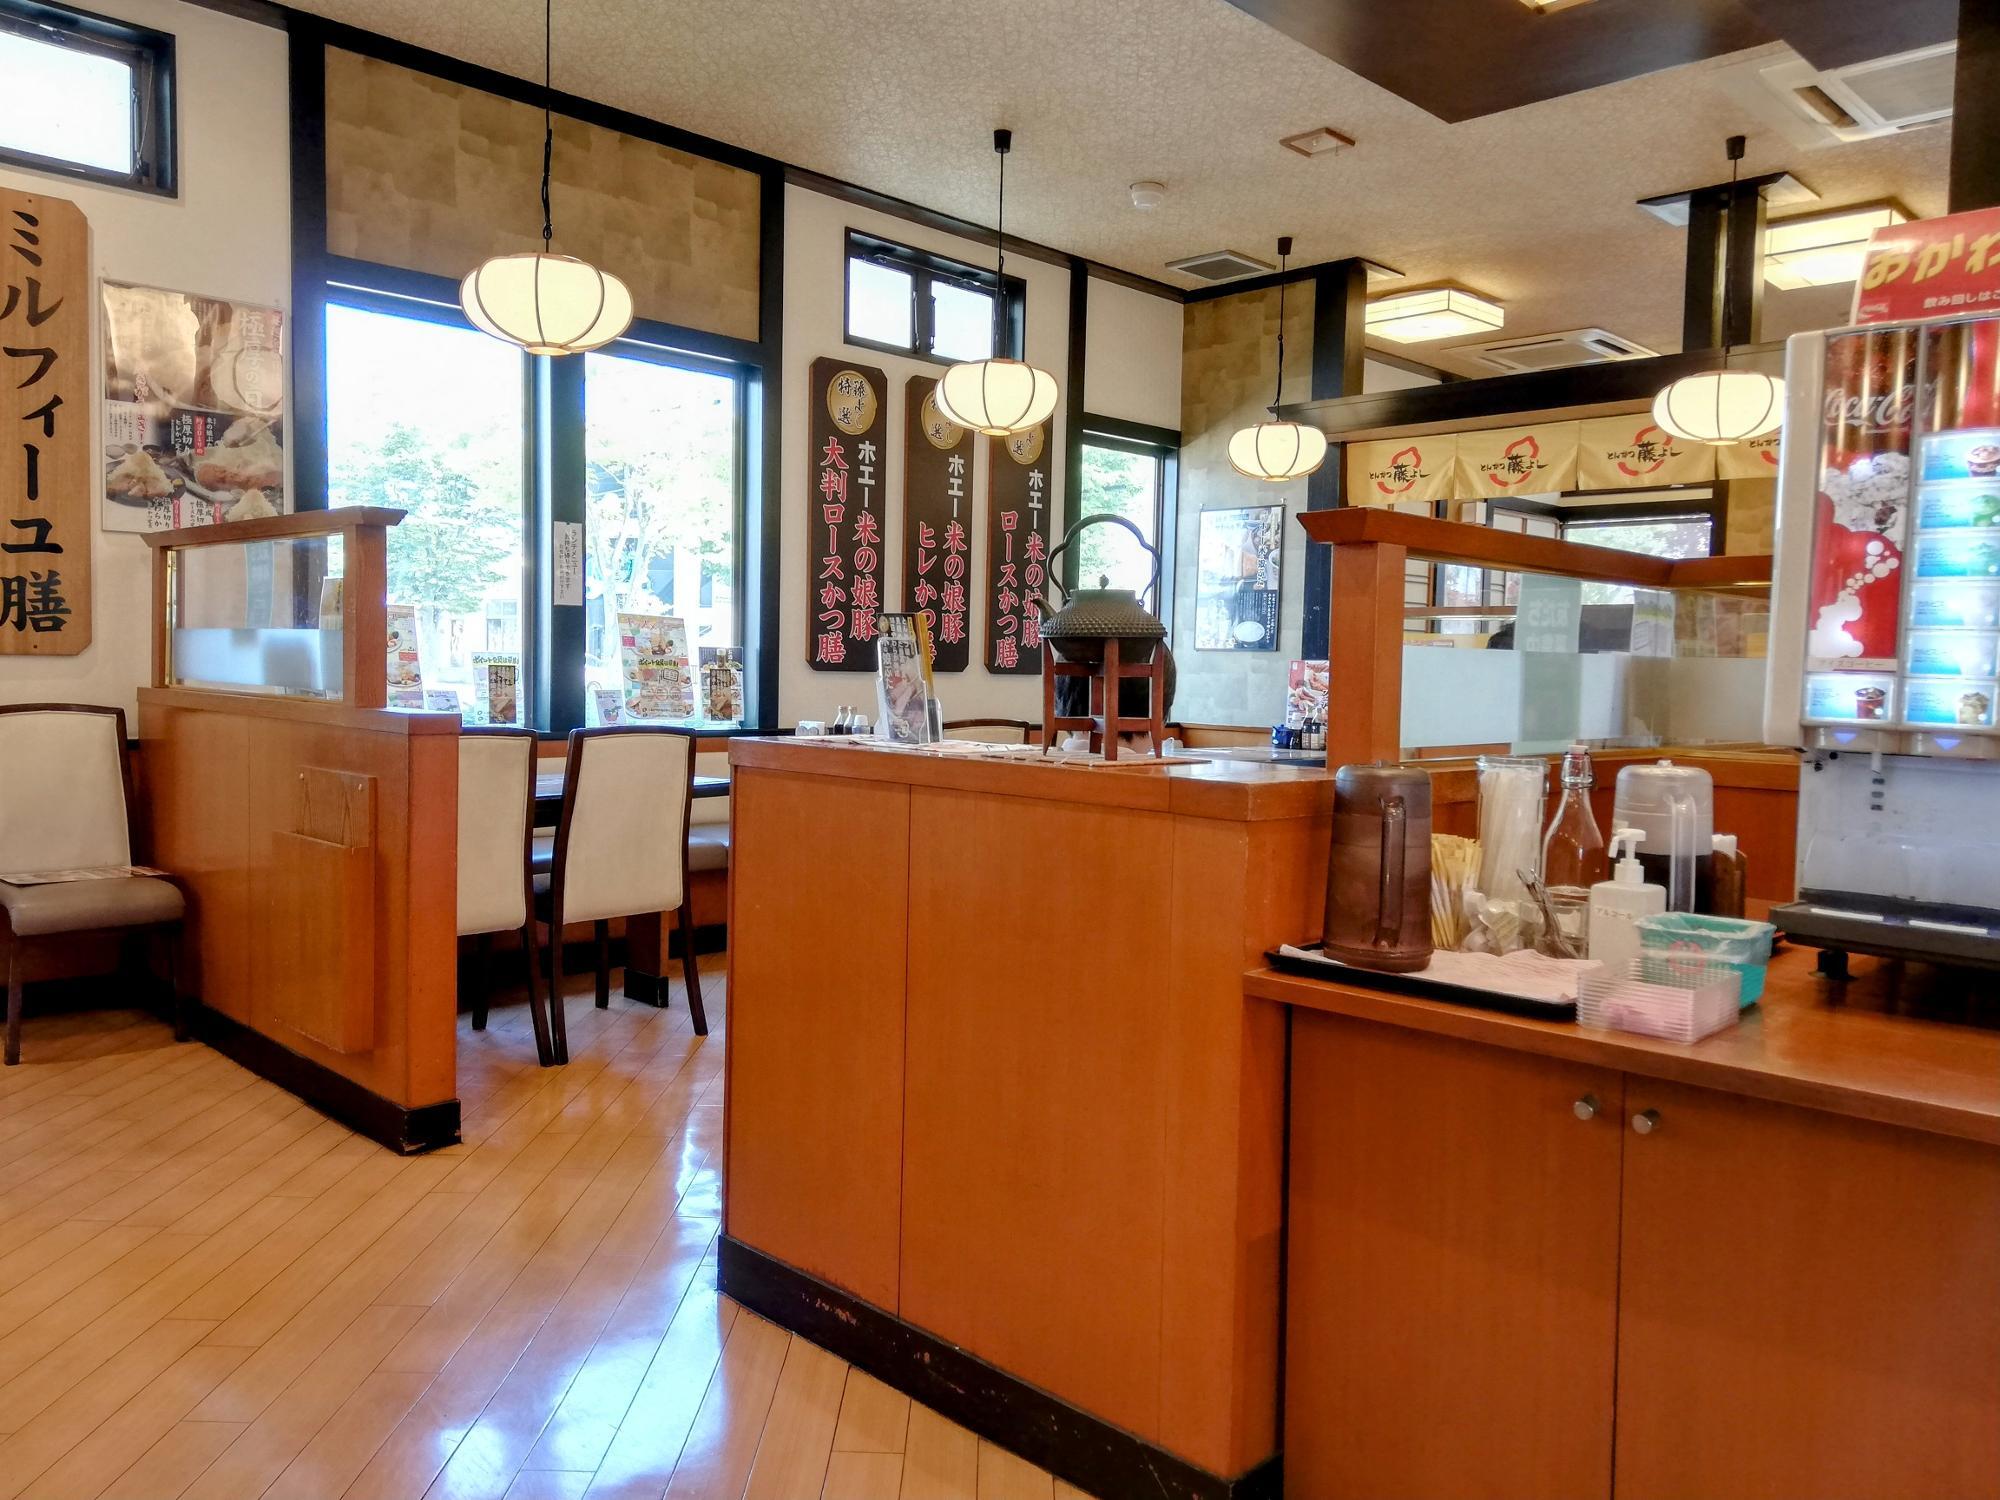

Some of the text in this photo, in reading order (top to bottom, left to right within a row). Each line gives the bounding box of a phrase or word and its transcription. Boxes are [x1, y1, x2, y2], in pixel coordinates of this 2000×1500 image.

[0, 209, 72, 633] ミルフィーユ膳
[816, 435, 850, 664] 大判ロースかつ膳
[995, 510, 1019, 669] ロースかつ膳
